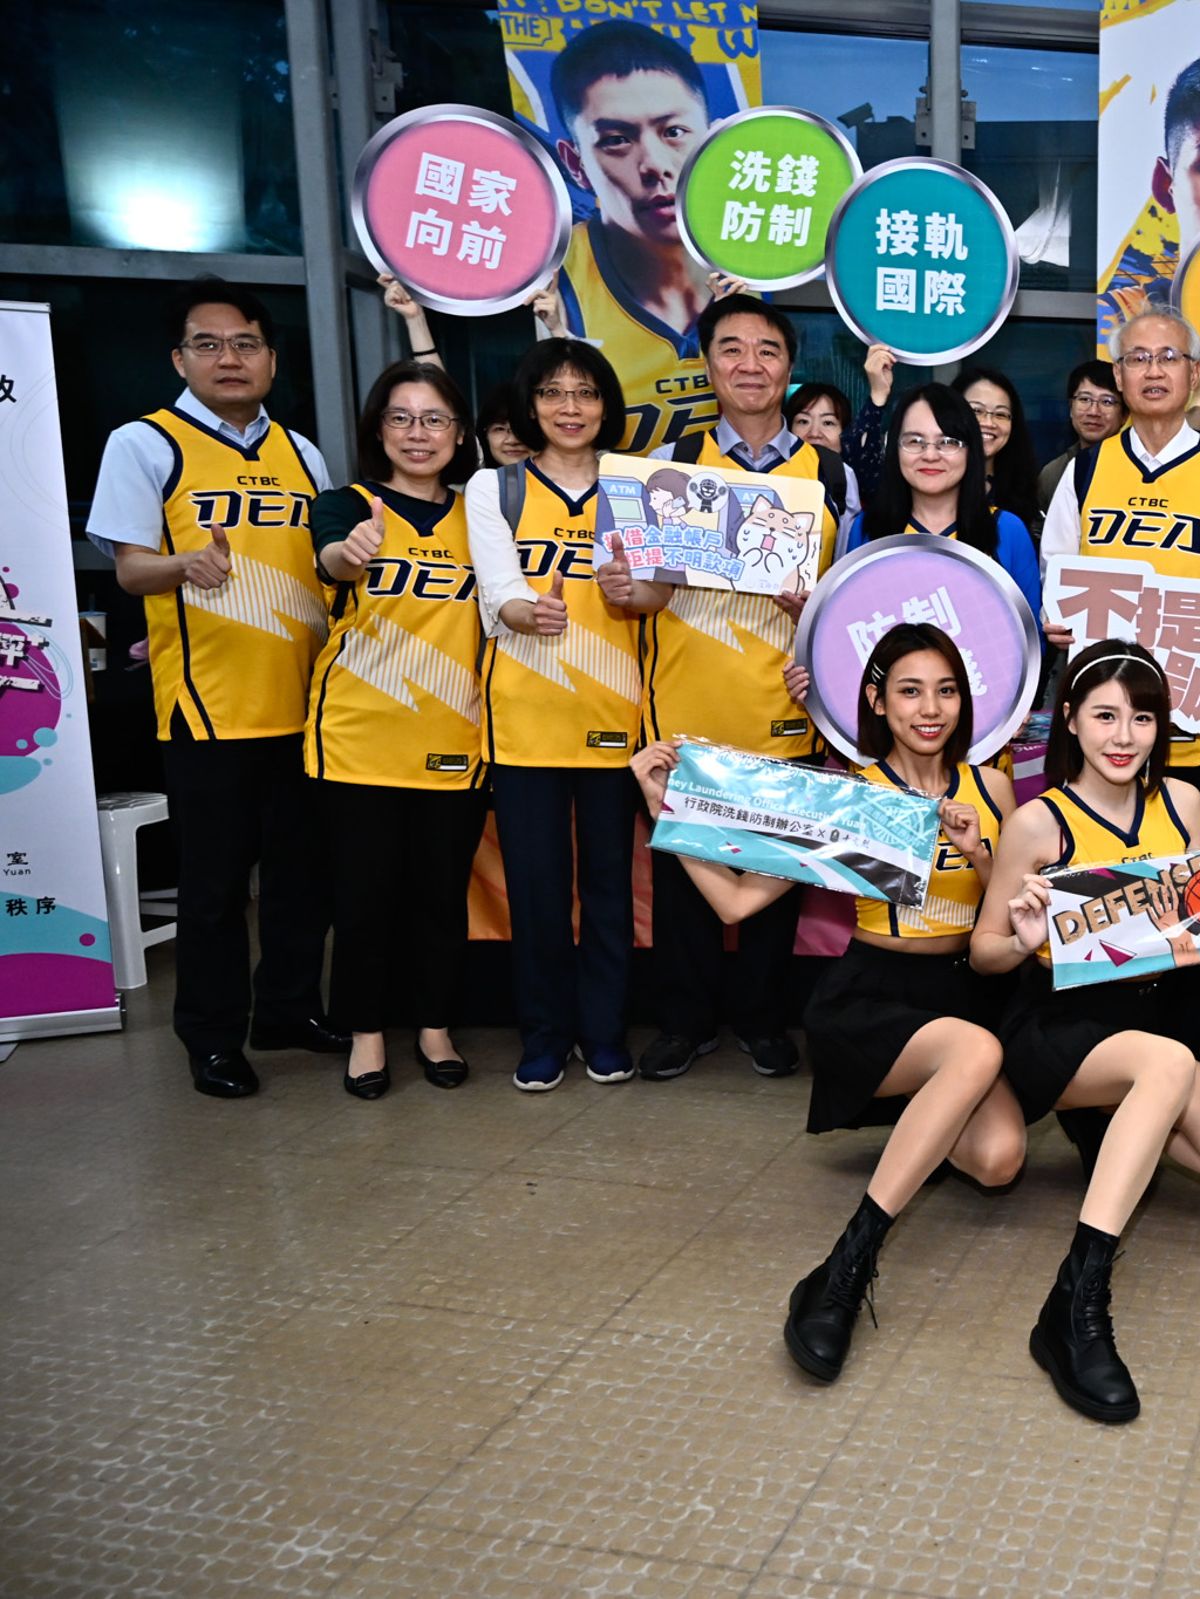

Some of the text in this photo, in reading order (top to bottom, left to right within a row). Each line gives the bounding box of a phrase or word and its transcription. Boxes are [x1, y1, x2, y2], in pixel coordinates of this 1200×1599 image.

[504, 15, 540, 38] THE
[415, 152, 517, 216] 國家
[728, 150, 821, 198] 洗錢
[720, 201, 813, 247] 防制
[875, 208, 969, 261] 接軌
[405, 208, 507, 270] 向前
[876, 267, 968, 317] 國際
[655, 374, 710, 395] CTB
[615, 392, 720, 453] DE
[237, 475, 280, 487] CTBC
[609, 484, 636, 496] ATM
[1128, 496, 1169, 508] CTBC
[408, 547, 454, 559] CTBC
[515, 539, 594, 580] DE
[7, 852, 28, 866] 室
[3, 868, 31, 876] Yuan
[6, 896, 57, 916] 秩序
